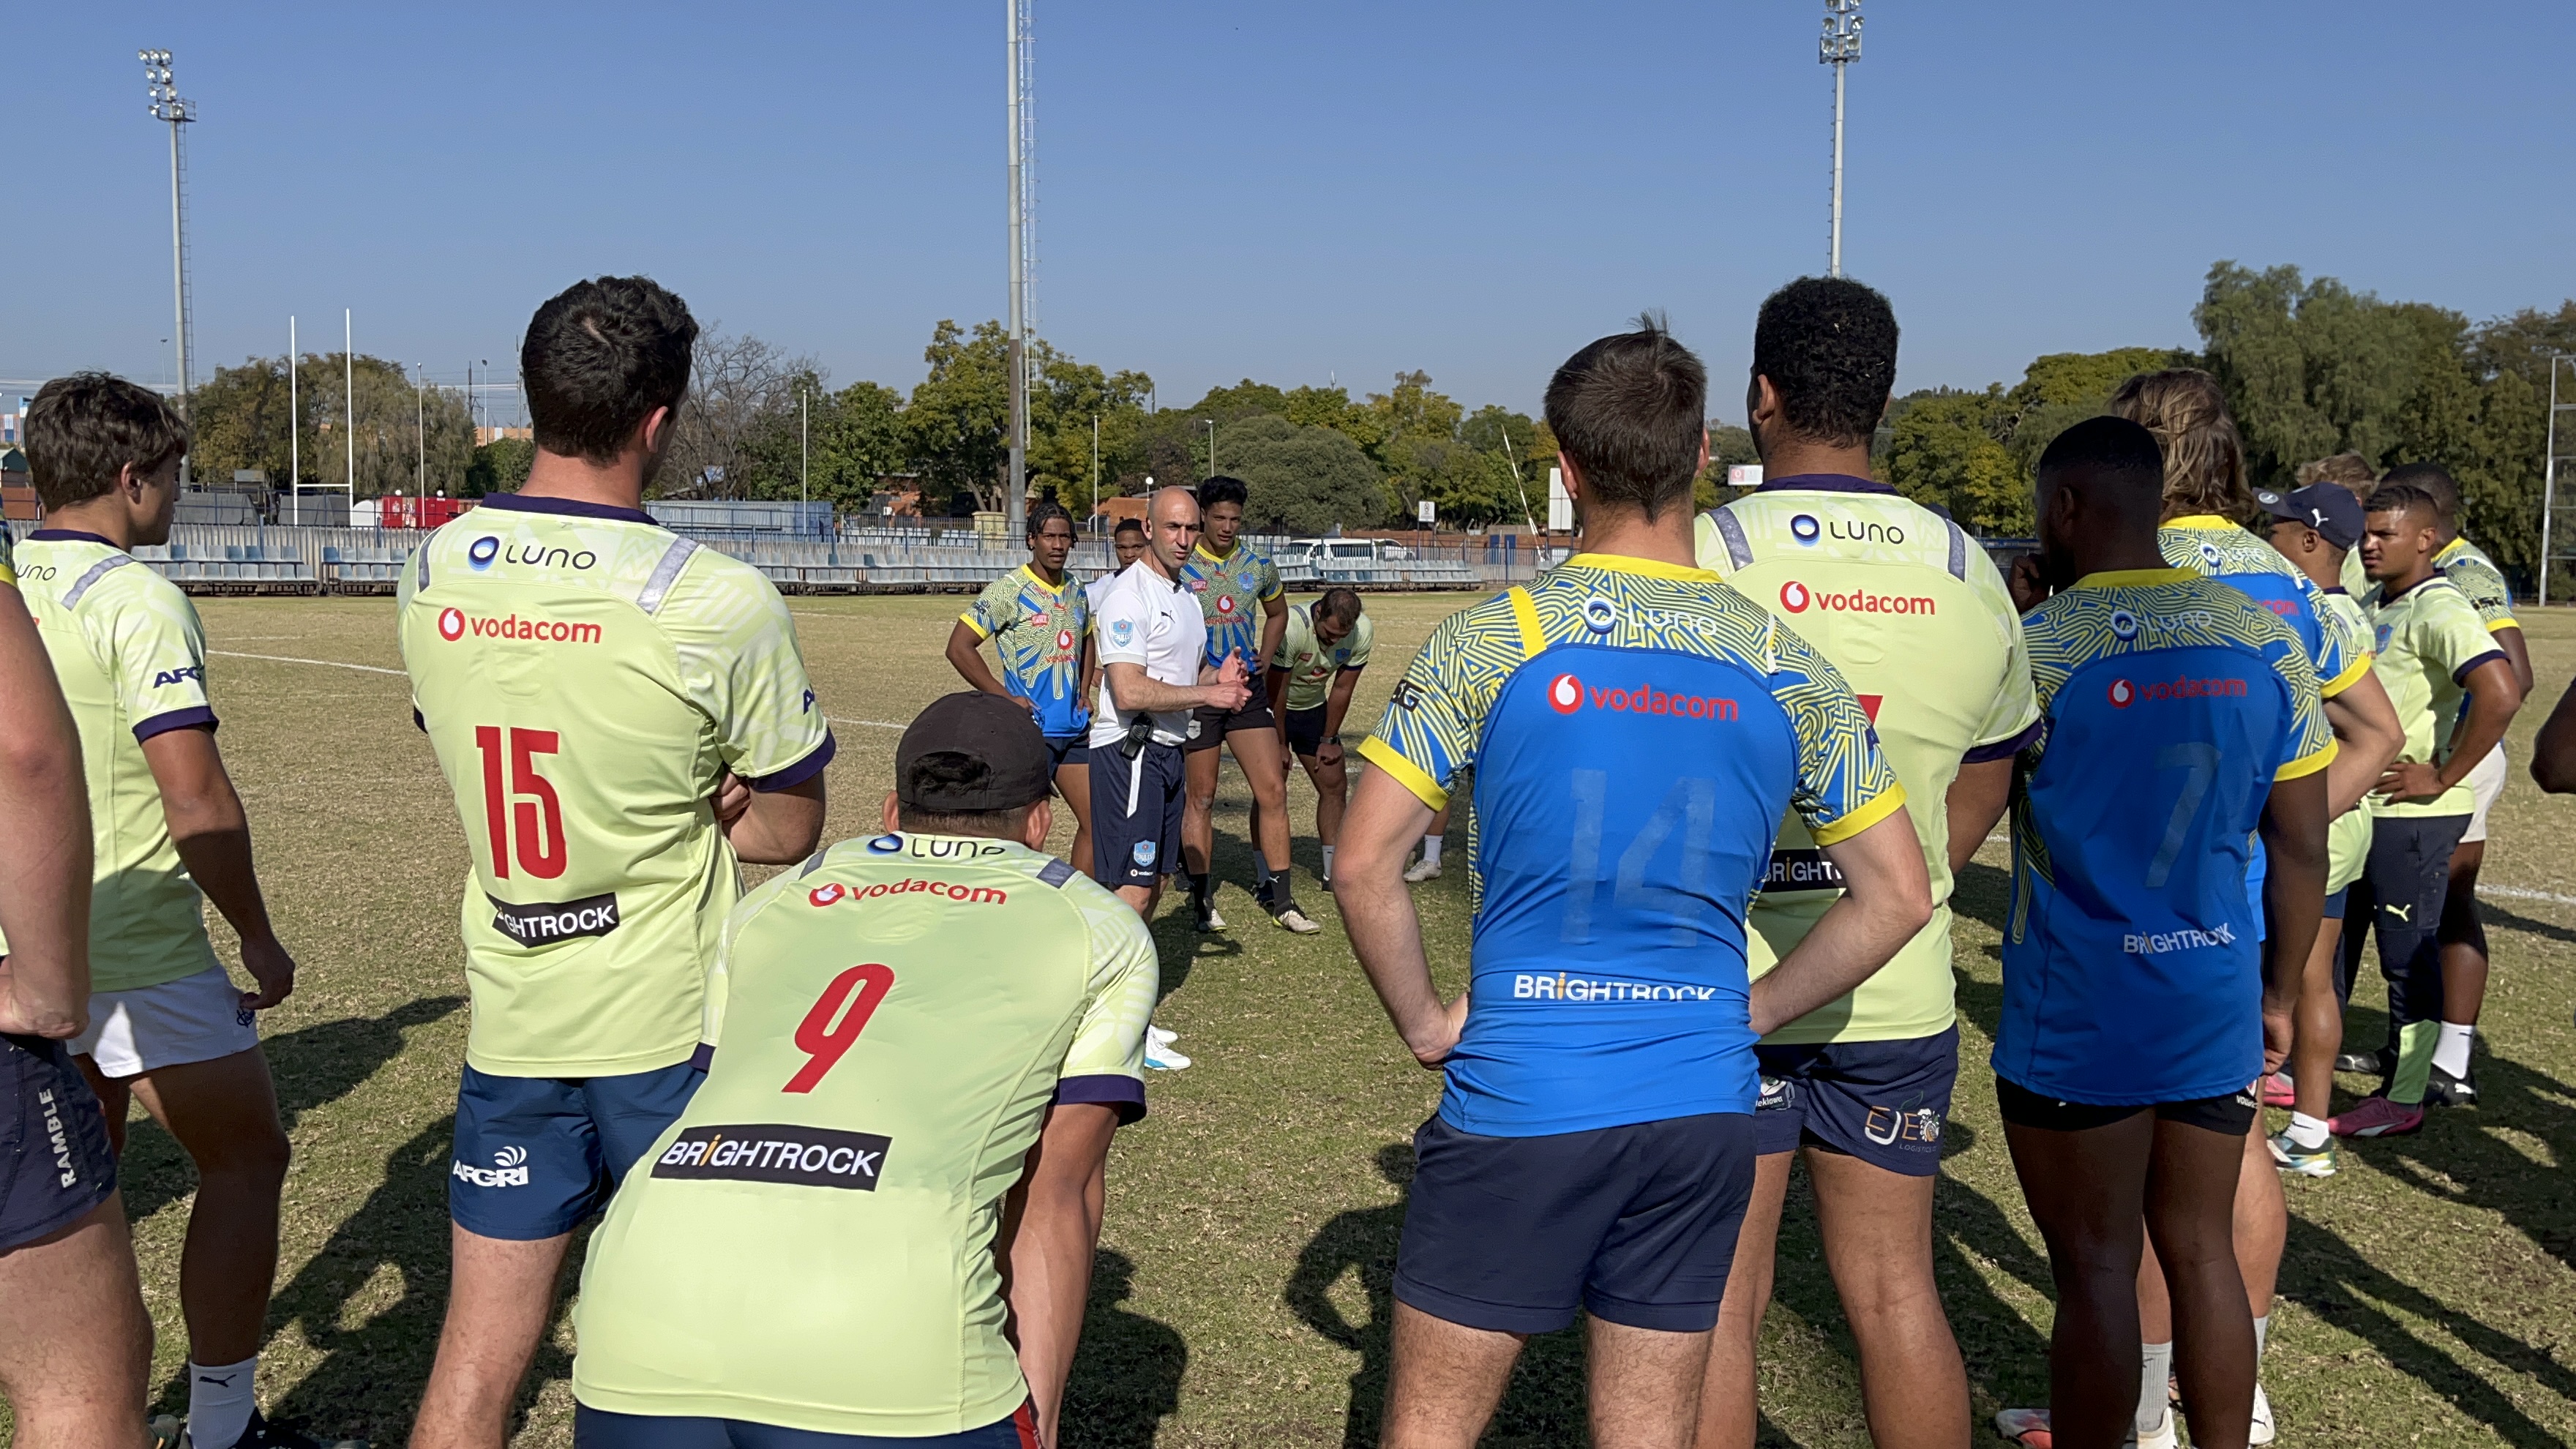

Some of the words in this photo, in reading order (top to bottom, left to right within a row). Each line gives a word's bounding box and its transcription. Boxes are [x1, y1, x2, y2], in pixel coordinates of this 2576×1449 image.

[1814, 589, 1936, 615] vodacom
[471, 614, 602, 644] vodacom
[1590, 684, 1739, 722] vodacom
[2141, 675, 2247, 701] vodacom
[476, 725, 567, 880] 15
[2145, 741, 2222, 888] 7
[1559, 768, 1716, 947] 14
[852, 878, 1008, 905] vodacom
[781, 963, 896, 1094] 9
[38, 1087, 77, 1188] RAMBLE
[452, 1159, 528, 1188] AFGRI
